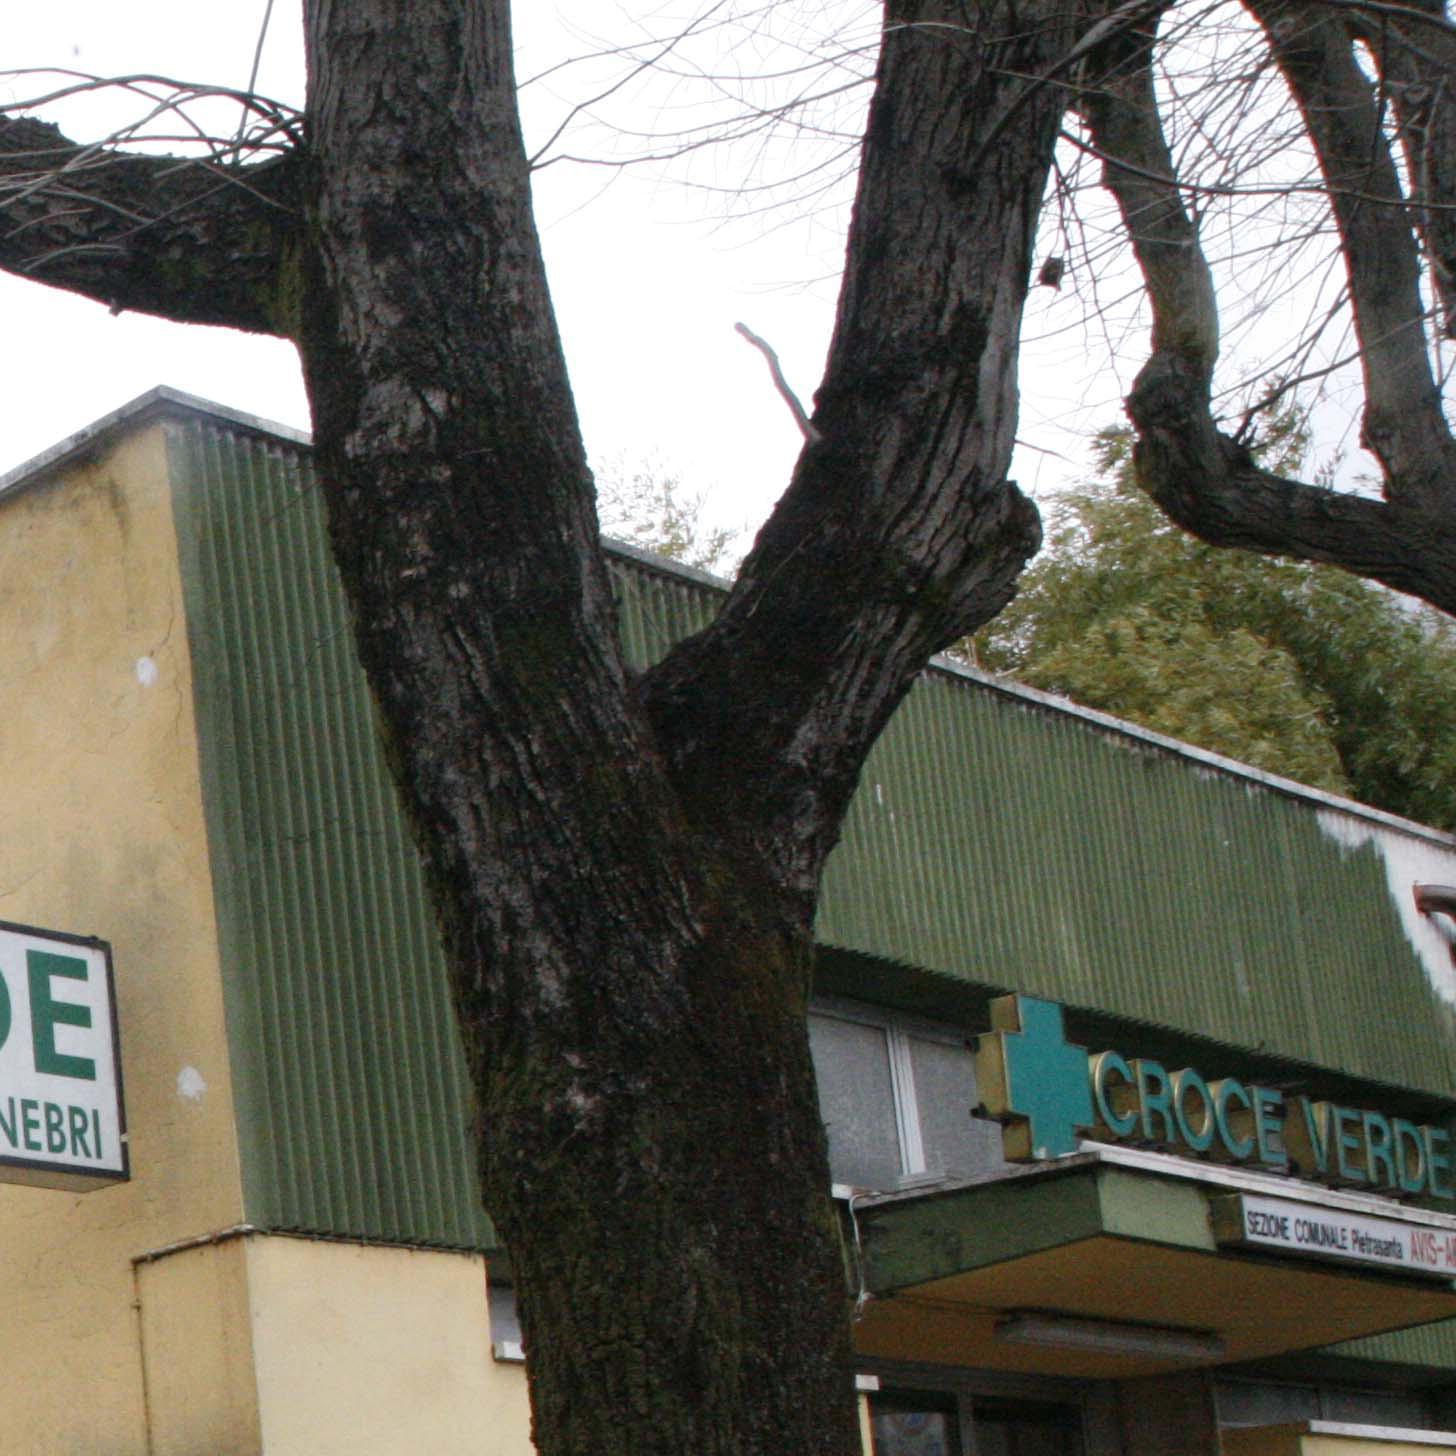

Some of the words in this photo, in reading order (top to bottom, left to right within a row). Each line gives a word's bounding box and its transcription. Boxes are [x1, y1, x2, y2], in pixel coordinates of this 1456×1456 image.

[1091, 1050, 1288, 1165] CROCE
[1300, 1097, 1456, 1200] VERDE
[1246, 1210, 1291, 1240] SEZIONE
[1294, 1218, 1348, 1250] COMUNALE
[1351, 1229, 1404, 1260] Pietrasanta
